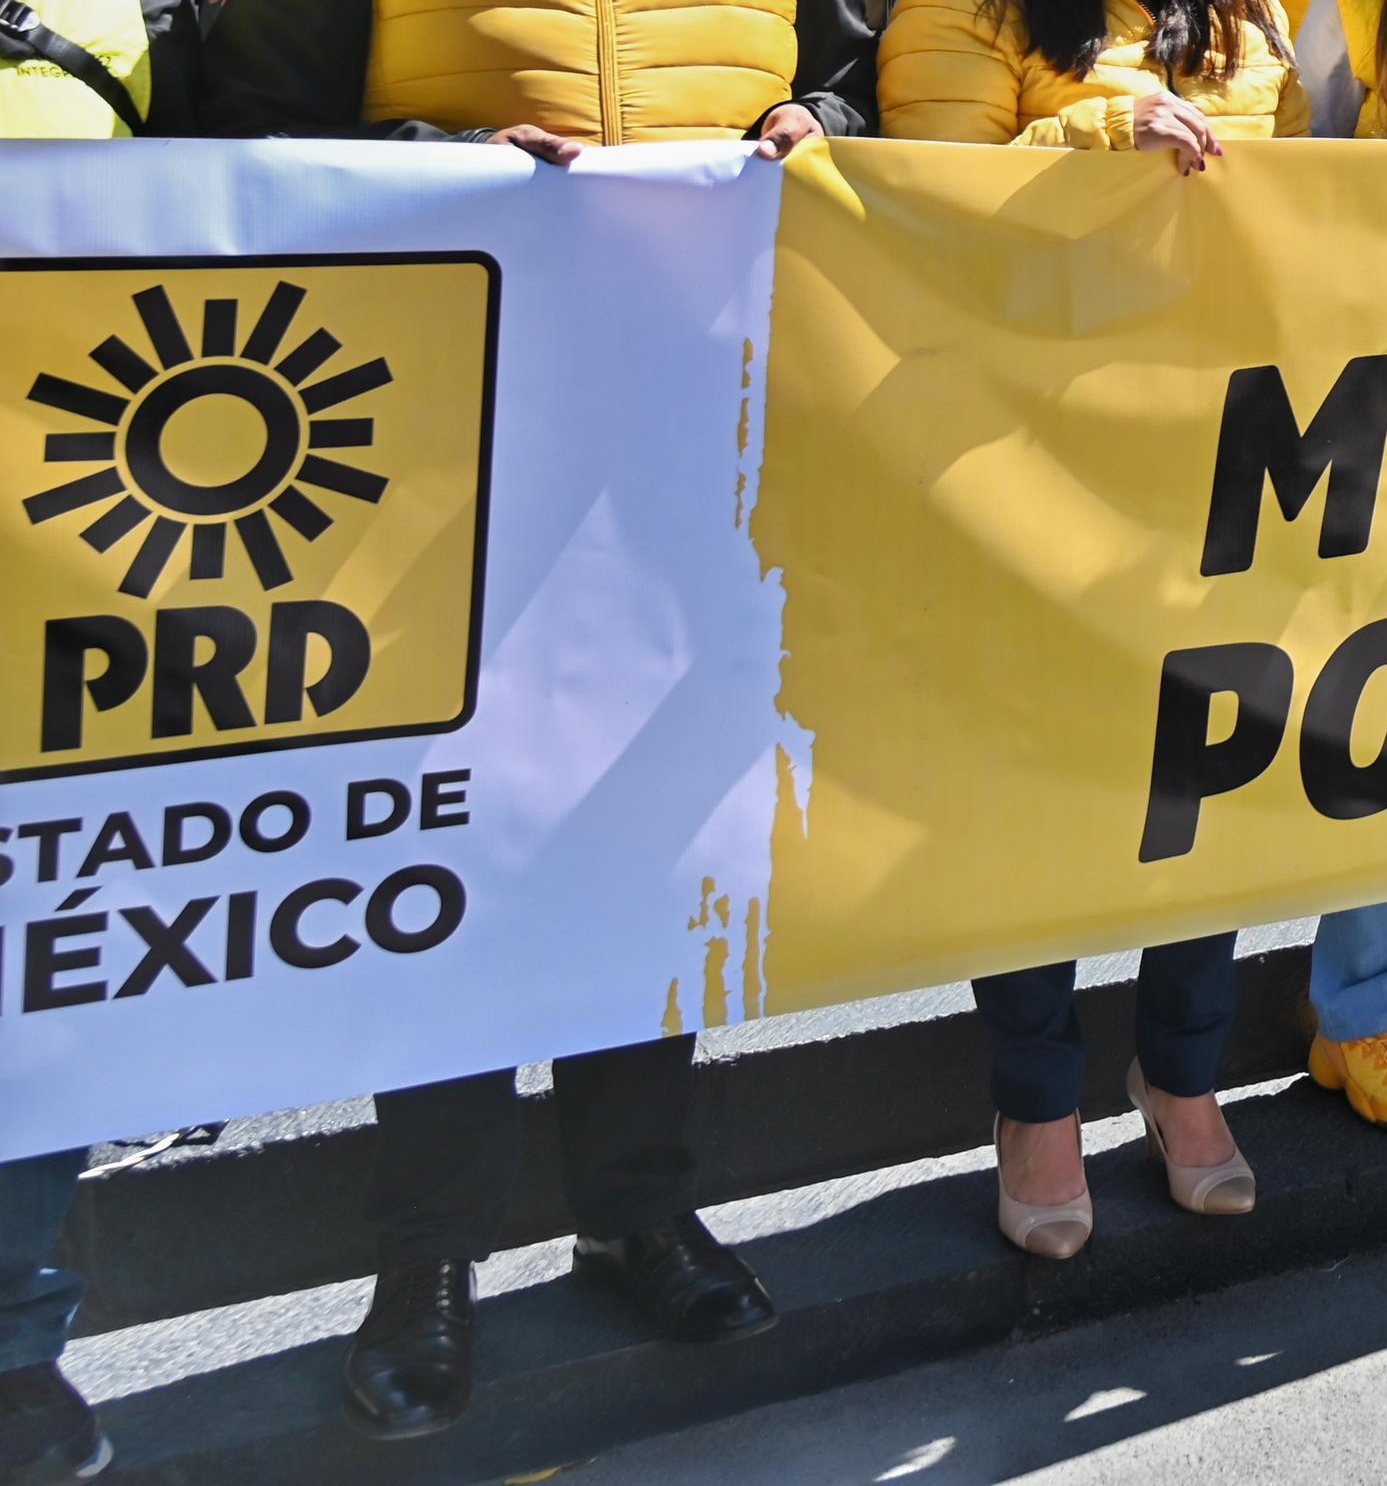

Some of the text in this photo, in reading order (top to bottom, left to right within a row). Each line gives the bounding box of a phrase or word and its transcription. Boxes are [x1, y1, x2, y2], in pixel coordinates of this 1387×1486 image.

[41, 599, 371, 753] PRD
[345, 767, 472, 841] DE
[0, 863, 467, 1016] ÉXICO
